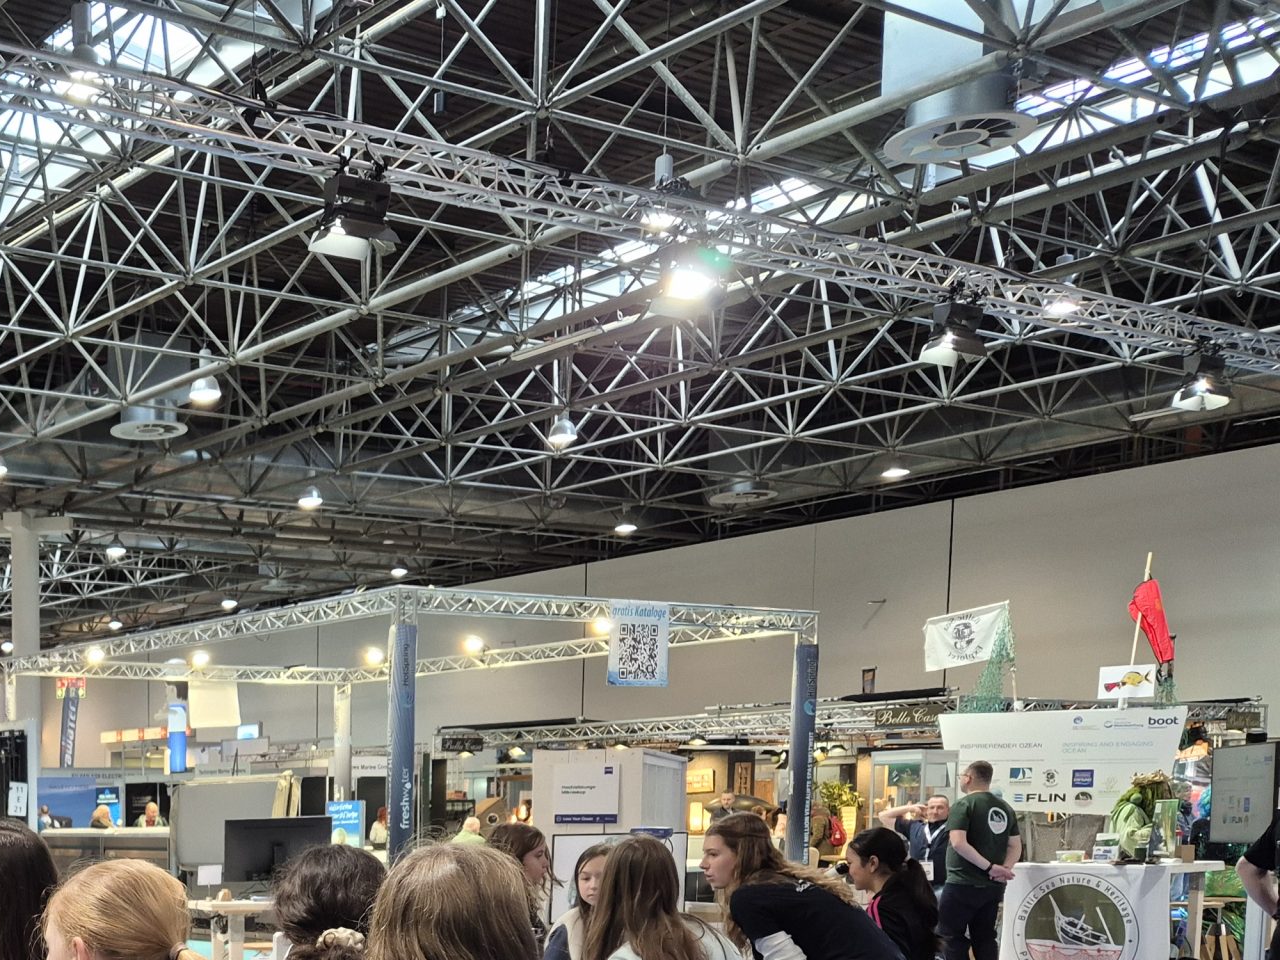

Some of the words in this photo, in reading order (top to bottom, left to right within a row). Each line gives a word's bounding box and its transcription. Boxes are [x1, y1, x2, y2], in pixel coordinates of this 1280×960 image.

[612, 606, 634, 617] gratis
[634, 606, 667, 620] Kataloge
[402, 643, 410, 687] HotSpring
[876, 710, 911, 725] Bella
[1148, 716, 1179, 725] boot
[1025, 793, 1066, 802] FLIN
[1018, 893, 1039, 921] Baltic
[1040, 882, 1056, 894] Sea
[1059, 876, 1091, 885] Nature
[1104, 886, 1133, 924] Heritage
